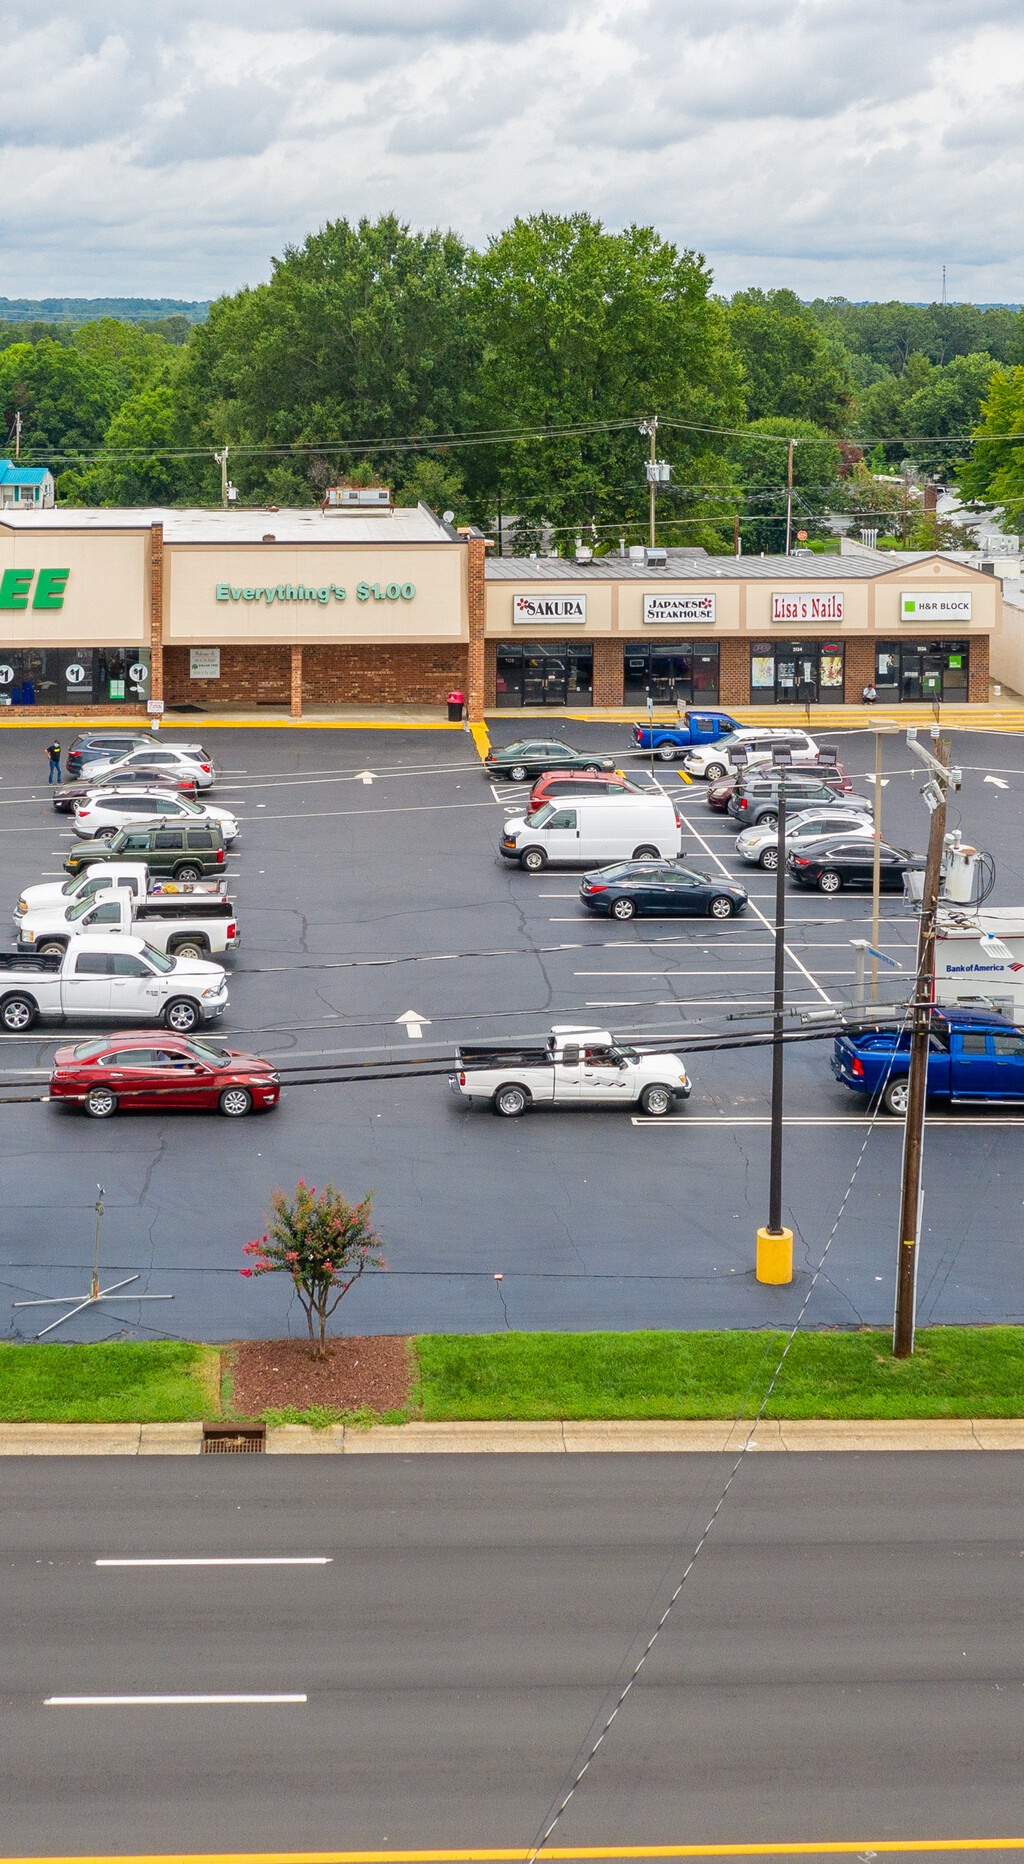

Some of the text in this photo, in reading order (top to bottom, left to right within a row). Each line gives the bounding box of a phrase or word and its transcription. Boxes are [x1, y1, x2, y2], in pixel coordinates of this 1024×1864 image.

[217, 582, 416, 603] Everything's $1.00
[527, 601, 583, 616] SAKURA
[774, 596, 843, 619] Lisa's Nails
[919, 602, 969, 610] H&R BLOCK
[647, 609, 713, 619] STEAKHOUSE
[0, 669, 9, 682] $1
[70, 668, 80, 681] $1
[133, 667, 144, 681] $1
[946, 963, 1005, 973] Bank of America
